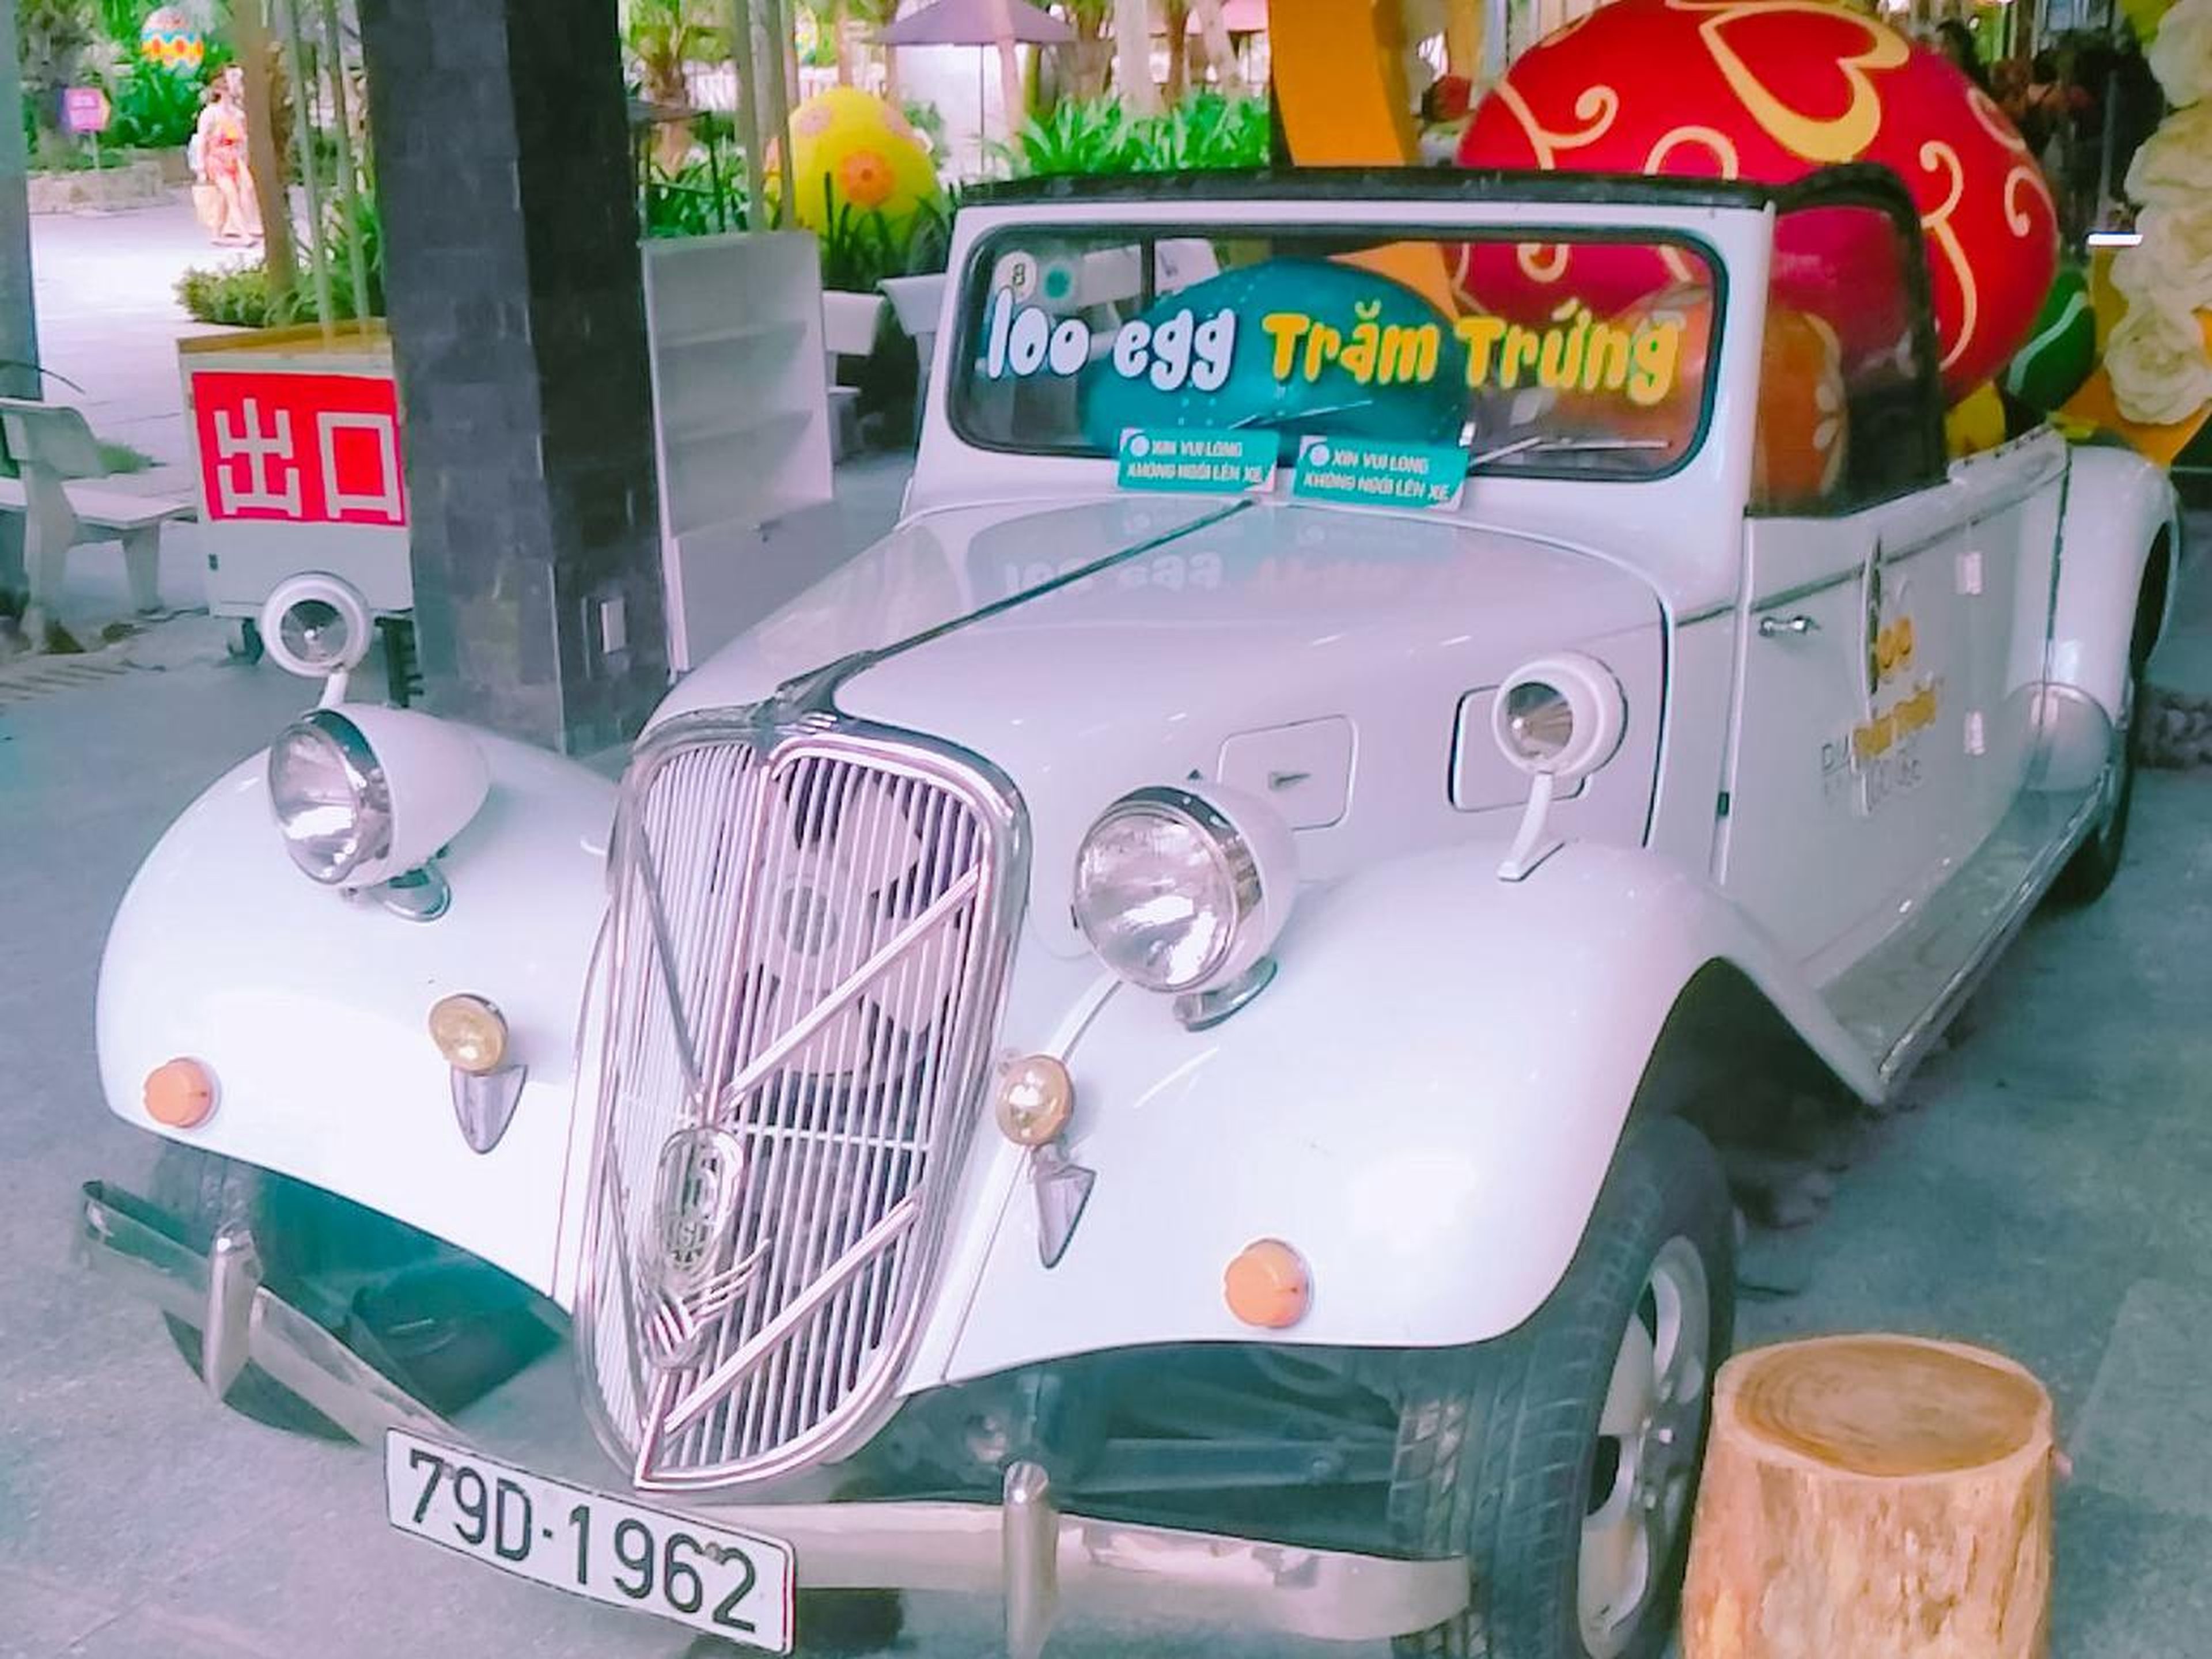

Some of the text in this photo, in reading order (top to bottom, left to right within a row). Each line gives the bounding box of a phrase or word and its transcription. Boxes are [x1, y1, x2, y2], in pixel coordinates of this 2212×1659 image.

[1113, 308, 1236, 392] egg
[1262, 300, 1440, 384] Trăm
[1454, 297, 1685, 404] Trứng
[214, 399, 402, 521] 出口
